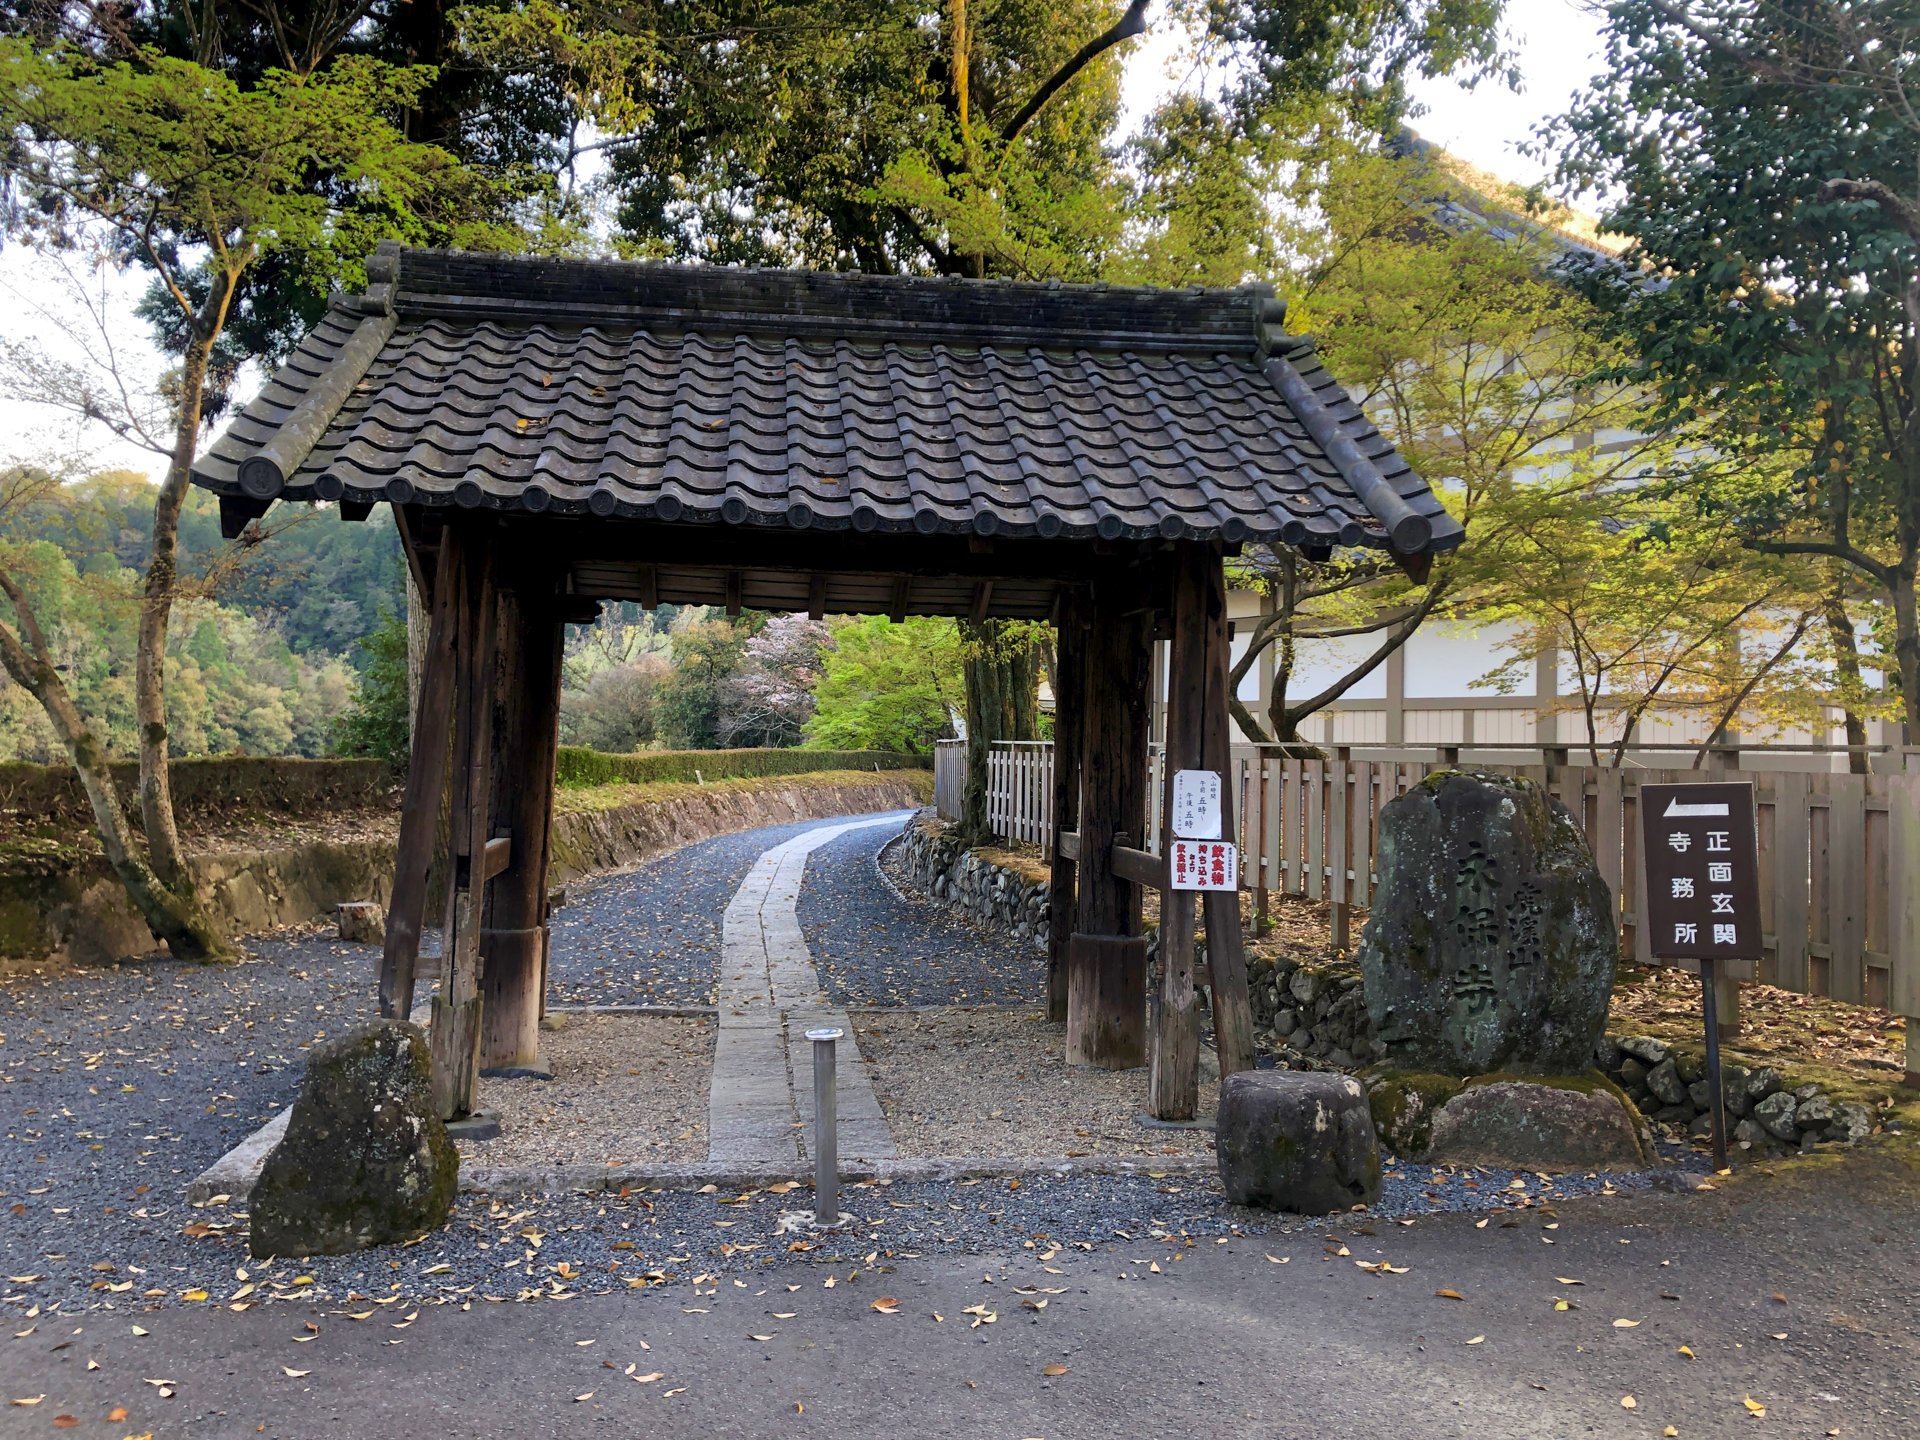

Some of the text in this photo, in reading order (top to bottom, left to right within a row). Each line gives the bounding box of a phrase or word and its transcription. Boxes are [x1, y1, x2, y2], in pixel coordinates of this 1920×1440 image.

[1176, 843, 1187, 884] 飲食禁止
[1197, 844, 1208, 886] 持ち込み
[1211, 844, 1225, 886] 飲食物
[1668, 831, 1698, 944] 寺務所
[1706, 831, 1737, 945] 正面玄関
[1450, 840, 1503, 1018] 永保寺
